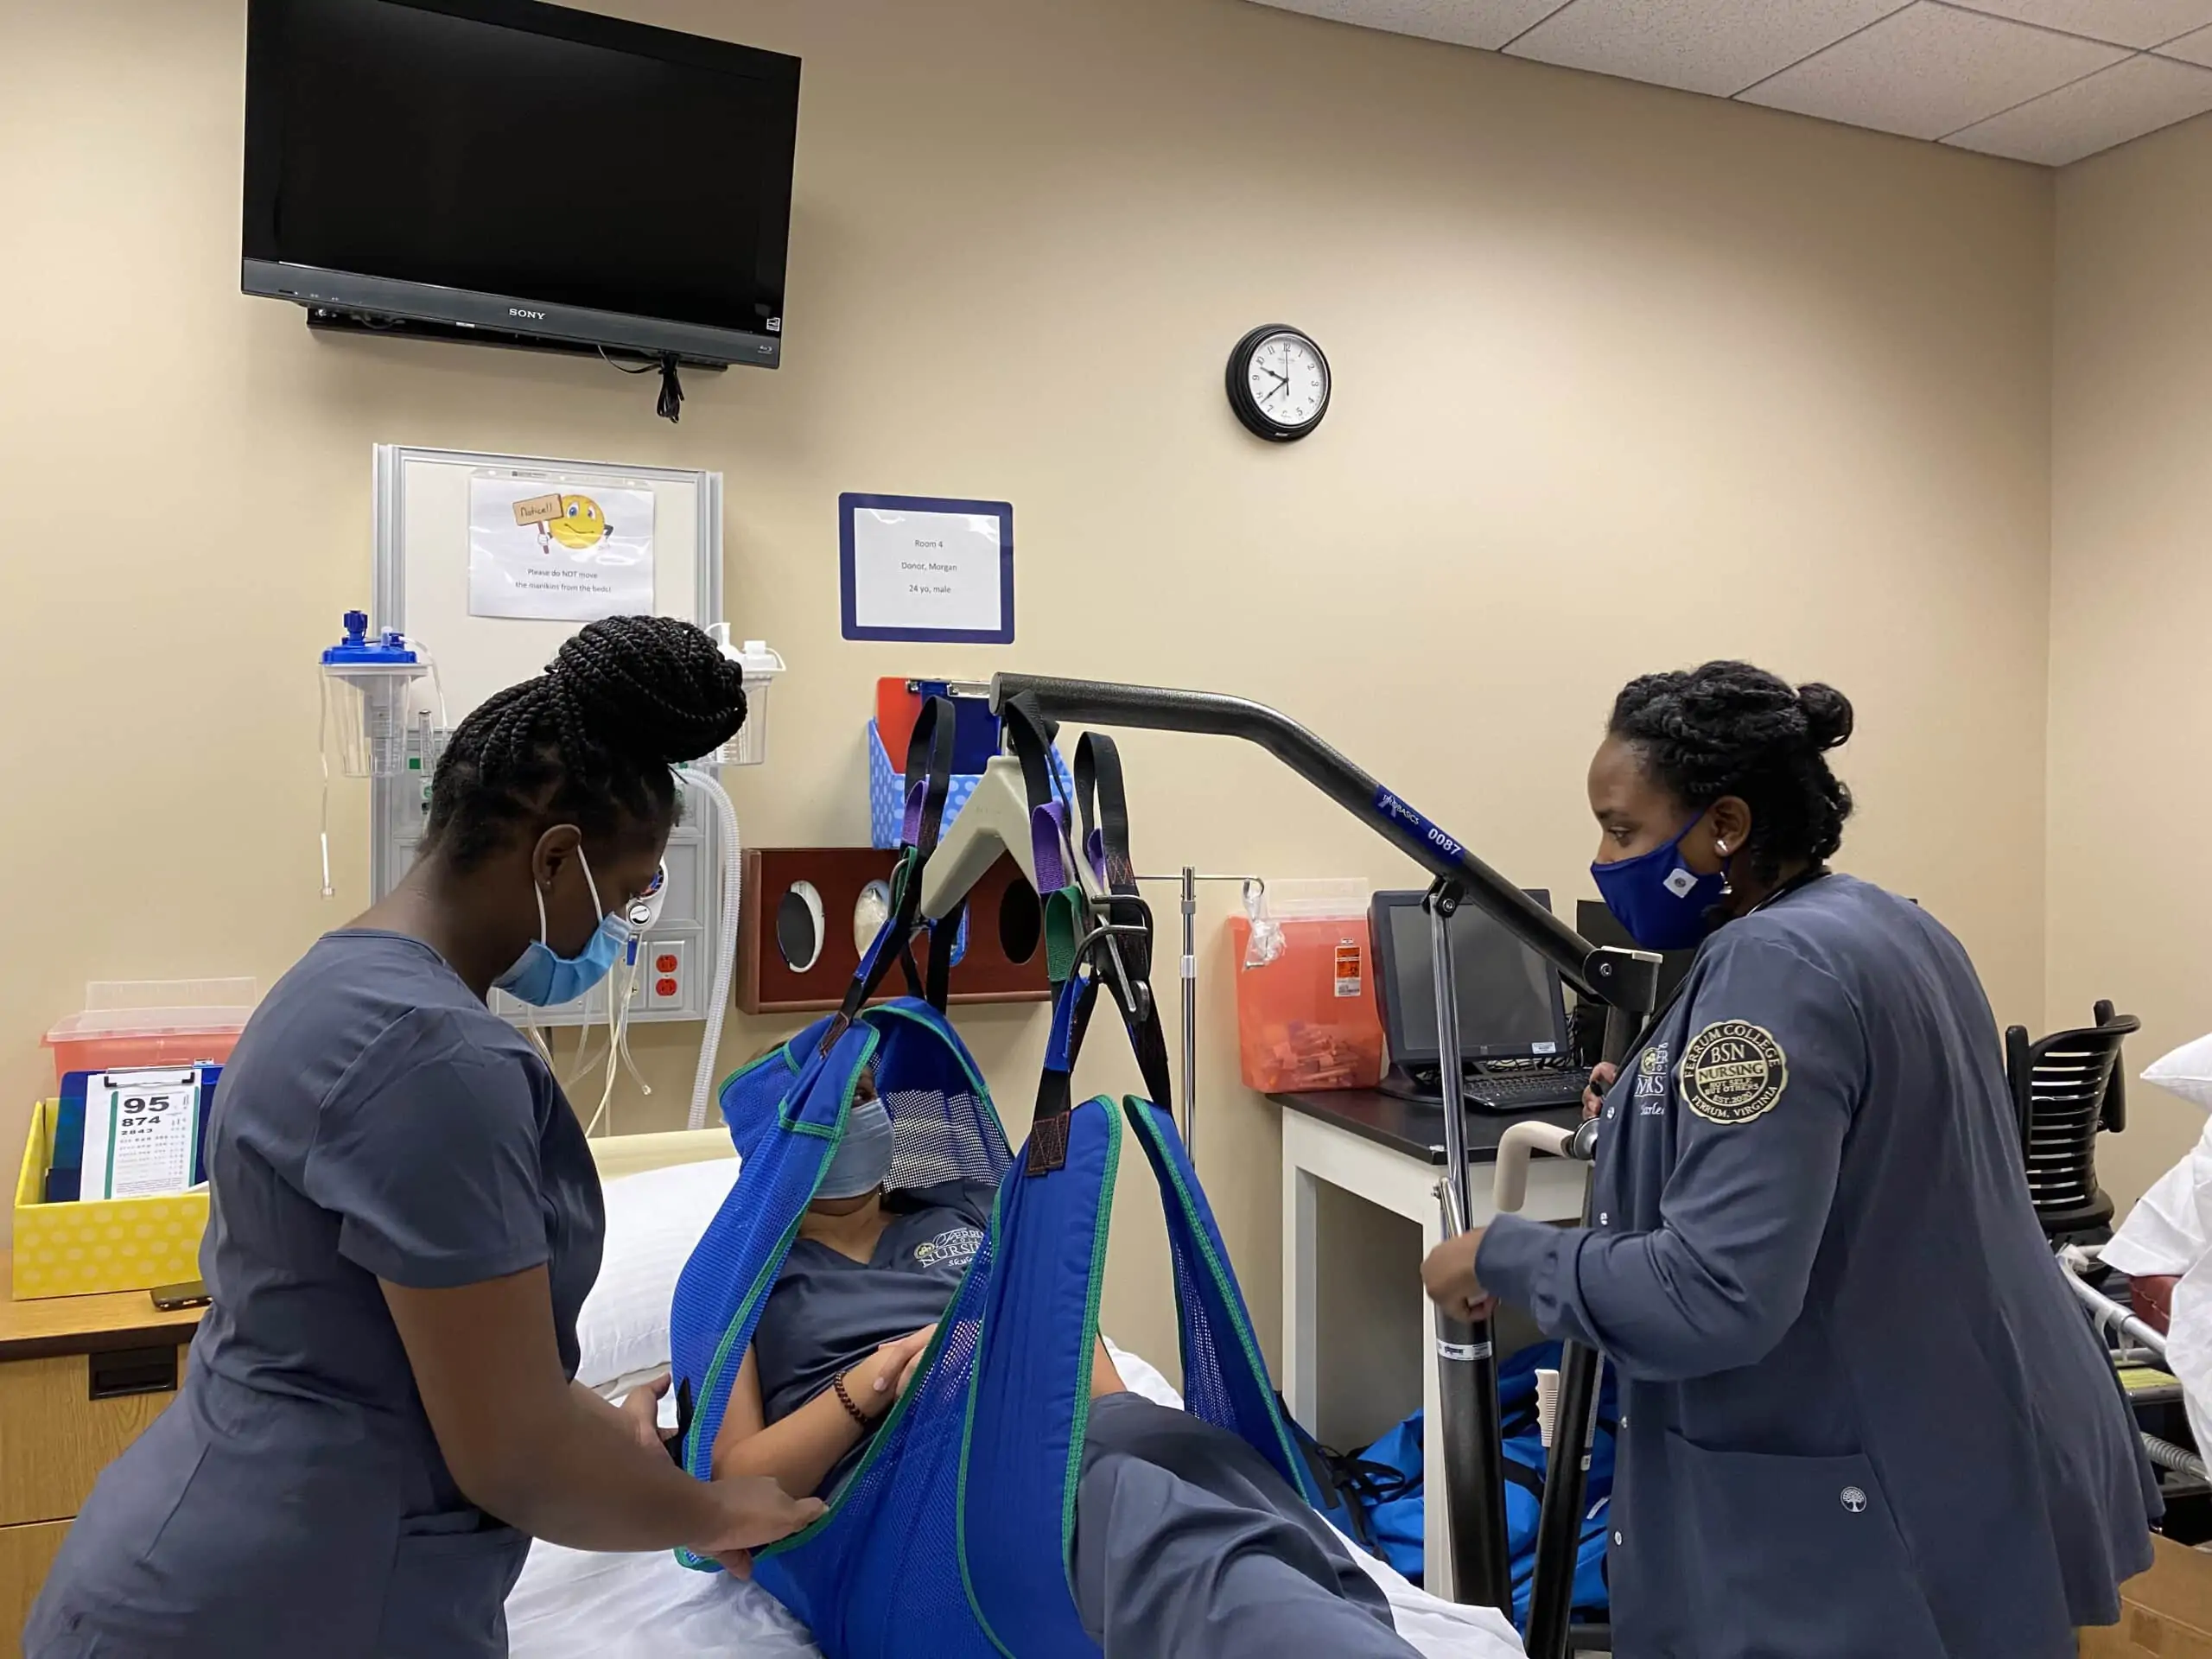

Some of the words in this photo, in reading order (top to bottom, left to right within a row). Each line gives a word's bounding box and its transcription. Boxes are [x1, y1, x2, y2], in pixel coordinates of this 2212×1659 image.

[509, 308, 545, 320] SONY
[1267, 345, 1275, 355] 11
[1267, 404, 1274, 413] 7
[1296, 407, 1303, 416] 5
[914, 539, 937, 548] Room
[551, 569, 561, 577] do
[901, 562, 927, 570] Donor,
[929, 563, 957, 573] Morgan
[529, 582, 559, 590] manikins
[592, 584, 612, 593] beds!
[909, 584, 918, 593] 24
[933, 584, 951, 594] male
[1427, 828, 1461, 855] 0087
[1684, 1027, 1722, 1078] FERRUM
[1724, 1025, 1780, 1067] COLLEGE
[1711, 1042, 1745, 1064] BSN
[1699, 1063, 1764, 1081] NURSING
[1705, 1086, 1720, 1096] BUT
[1723, 1084, 1759, 1092] OTHERS
[124, 1096, 169, 1115] 95
[1733, 1086, 1777, 1117] VIRGINIA
[122, 1116, 162, 1127] 874
[918, 1243, 978, 1268] NURSI
